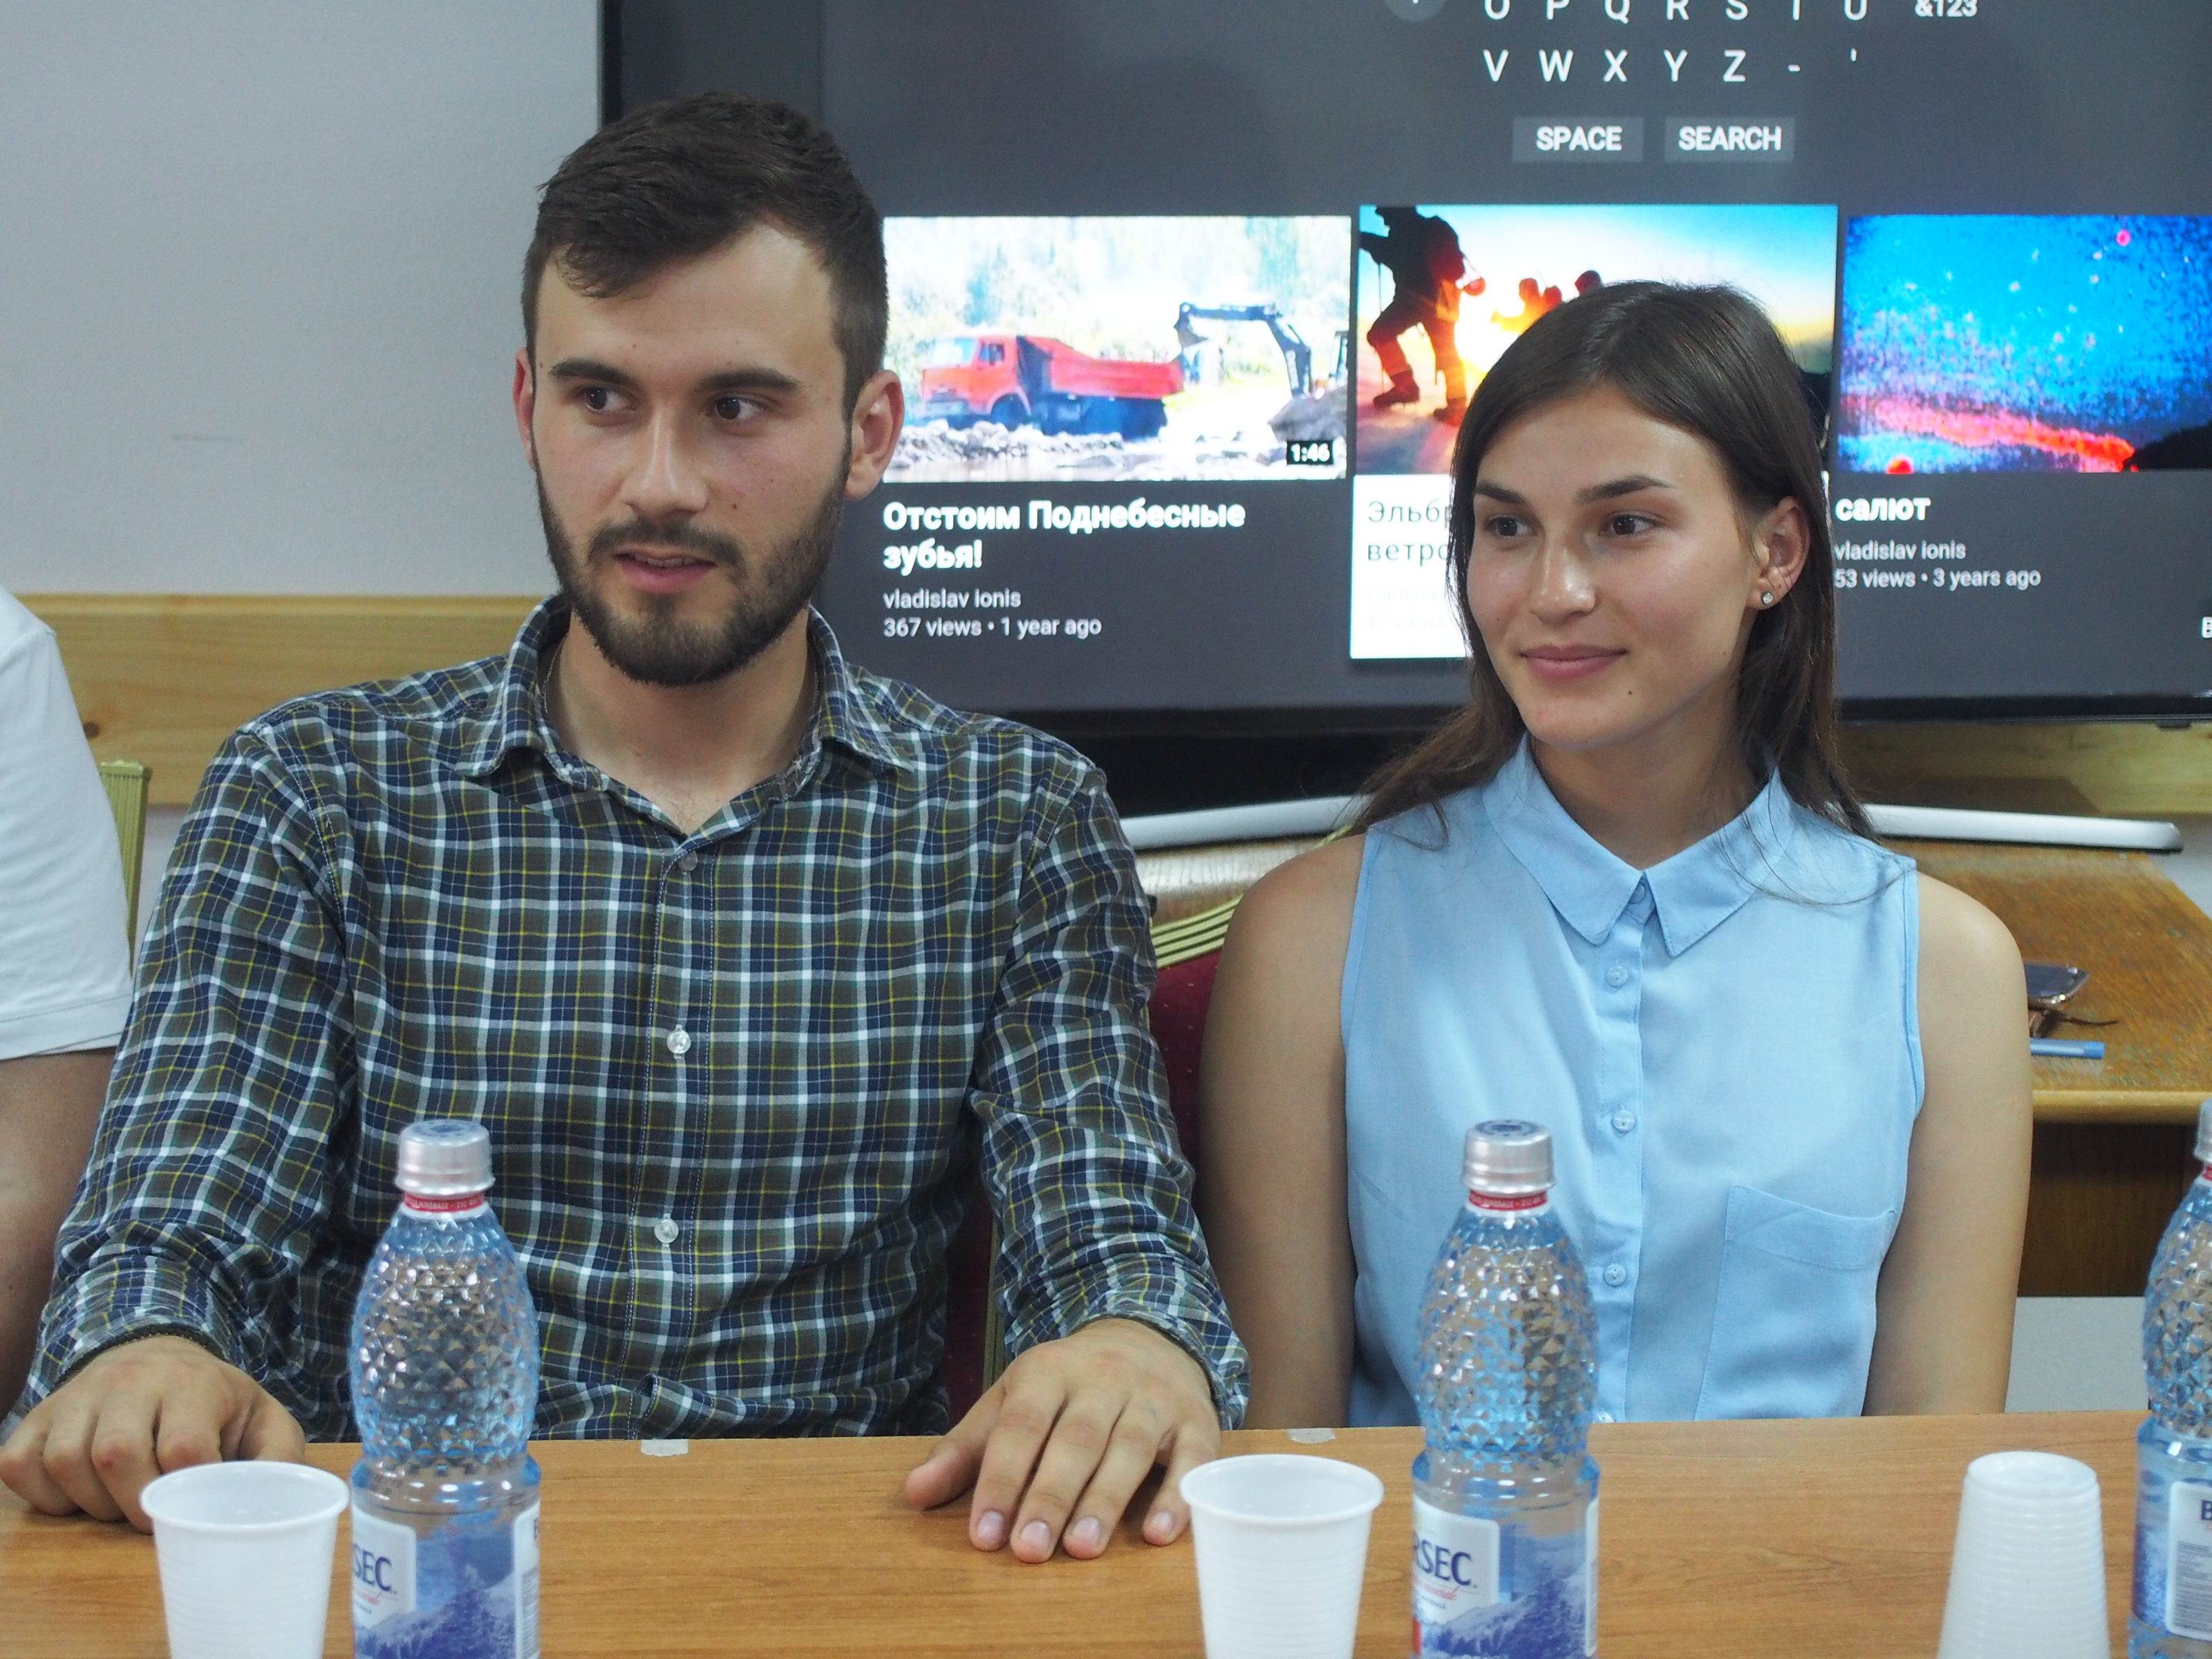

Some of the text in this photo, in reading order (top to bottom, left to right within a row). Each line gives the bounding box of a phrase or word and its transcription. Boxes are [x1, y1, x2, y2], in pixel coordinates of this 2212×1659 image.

[1604, 0, 1630, 24] Q
[1666, 0, 1689, 21] R
[1725, 0, 1748, 21] S
[1844, 0, 1868, 21] U
[1483, 49, 1509, 82] V
[1539, 49, 1574, 82] W
[1603, 49, 1628, 82] X
[1663, 49, 1688, 82] Y
[1723, 49, 1746, 82] Z
[1535, 126, 1623, 151] SPACE
[1678, 126, 1783, 151] SEARCH
[1291, 442, 1331, 462] 1:46
[883, 496, 1246, 534] Отстоим Поднебесные
[1835, 497, 1931, 522] салют
[882, 537, 983, 577] зубья!
[1834, 539, 1967, 561] vladislav ionis
[1862, 568, 1916, 588] views
[1933, 568, 1945, 588] 3
[1949, 570, 2001, 592] years
[2005, 570, 2042, 591] ago
[883, 588, 1022, 609] vladislav ionis
[883, 617, 1103, 640] 367 views 1 year ago
